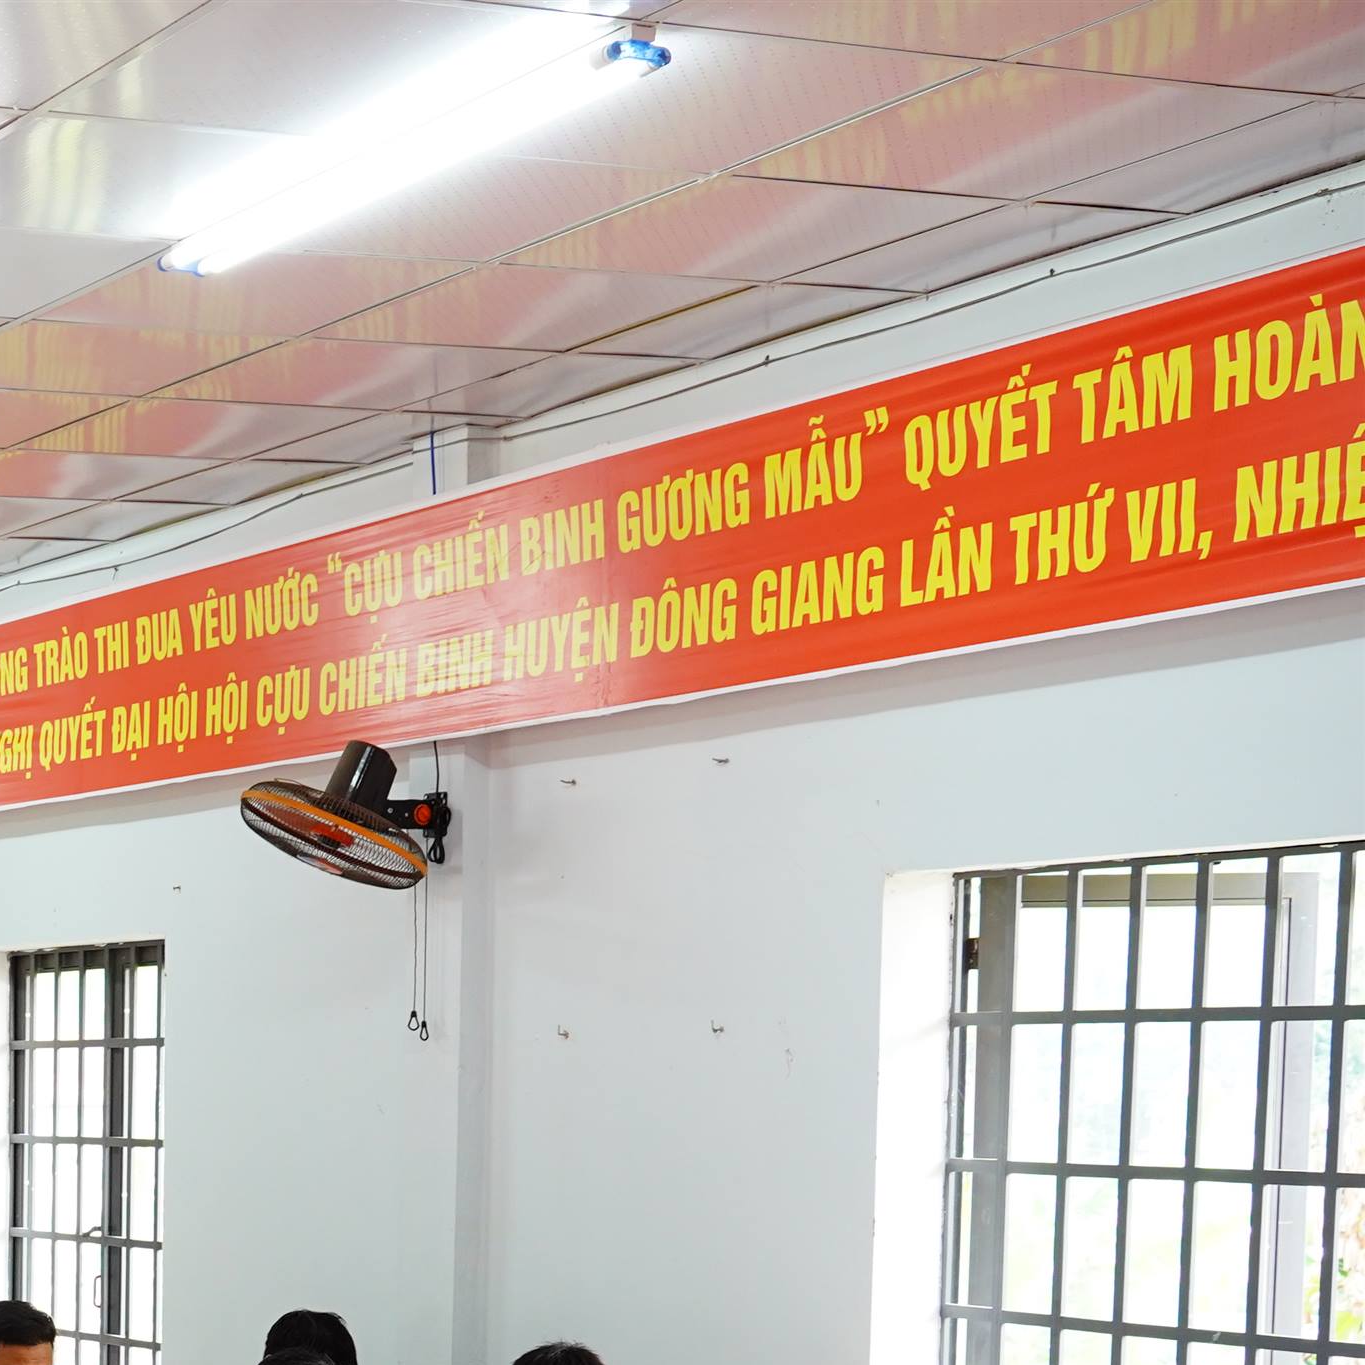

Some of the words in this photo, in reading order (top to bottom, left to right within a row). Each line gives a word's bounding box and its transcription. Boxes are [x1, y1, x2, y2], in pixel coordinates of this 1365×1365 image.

[34, 626, 89, 687] TRÀO
[95, 617, 130, 675] THI
[135, 608, 183, 666] ĐUA
[190, 591, 237, 656] YÊU
[245, 567, 319, 639] NƯỚC
[413, 511, 509, 599] CHIẾN
[521, 499, 606, 573] BINH
[616, 459, 751, 553] GƯƠNG
[903, 363, 1061, 492] QUYẾT
[1071, 344, 1194, 445] TÂM
[39, 696, 105, 771] QUYẾT
[111, 702, 152, 764] ĐẠI
[157, 683, 197, 755] HỘI
[205, 672, 247, 745] HỘI
[257, 664, 310, 735] CỰU
[319, 633, 407, 715] CHIẾN
[417, 627, 493, 699] BINH
[504, 598, 619, 682] HUYỆN
[630, 577, 738, 658] ĐÔNG
[750, 545, 885, 636] GIANG
[899, 504, 994, 608] LẦN
[1009, 485, 1116, 586] THỨ
[1126, 476, 1215, 564] VII,
